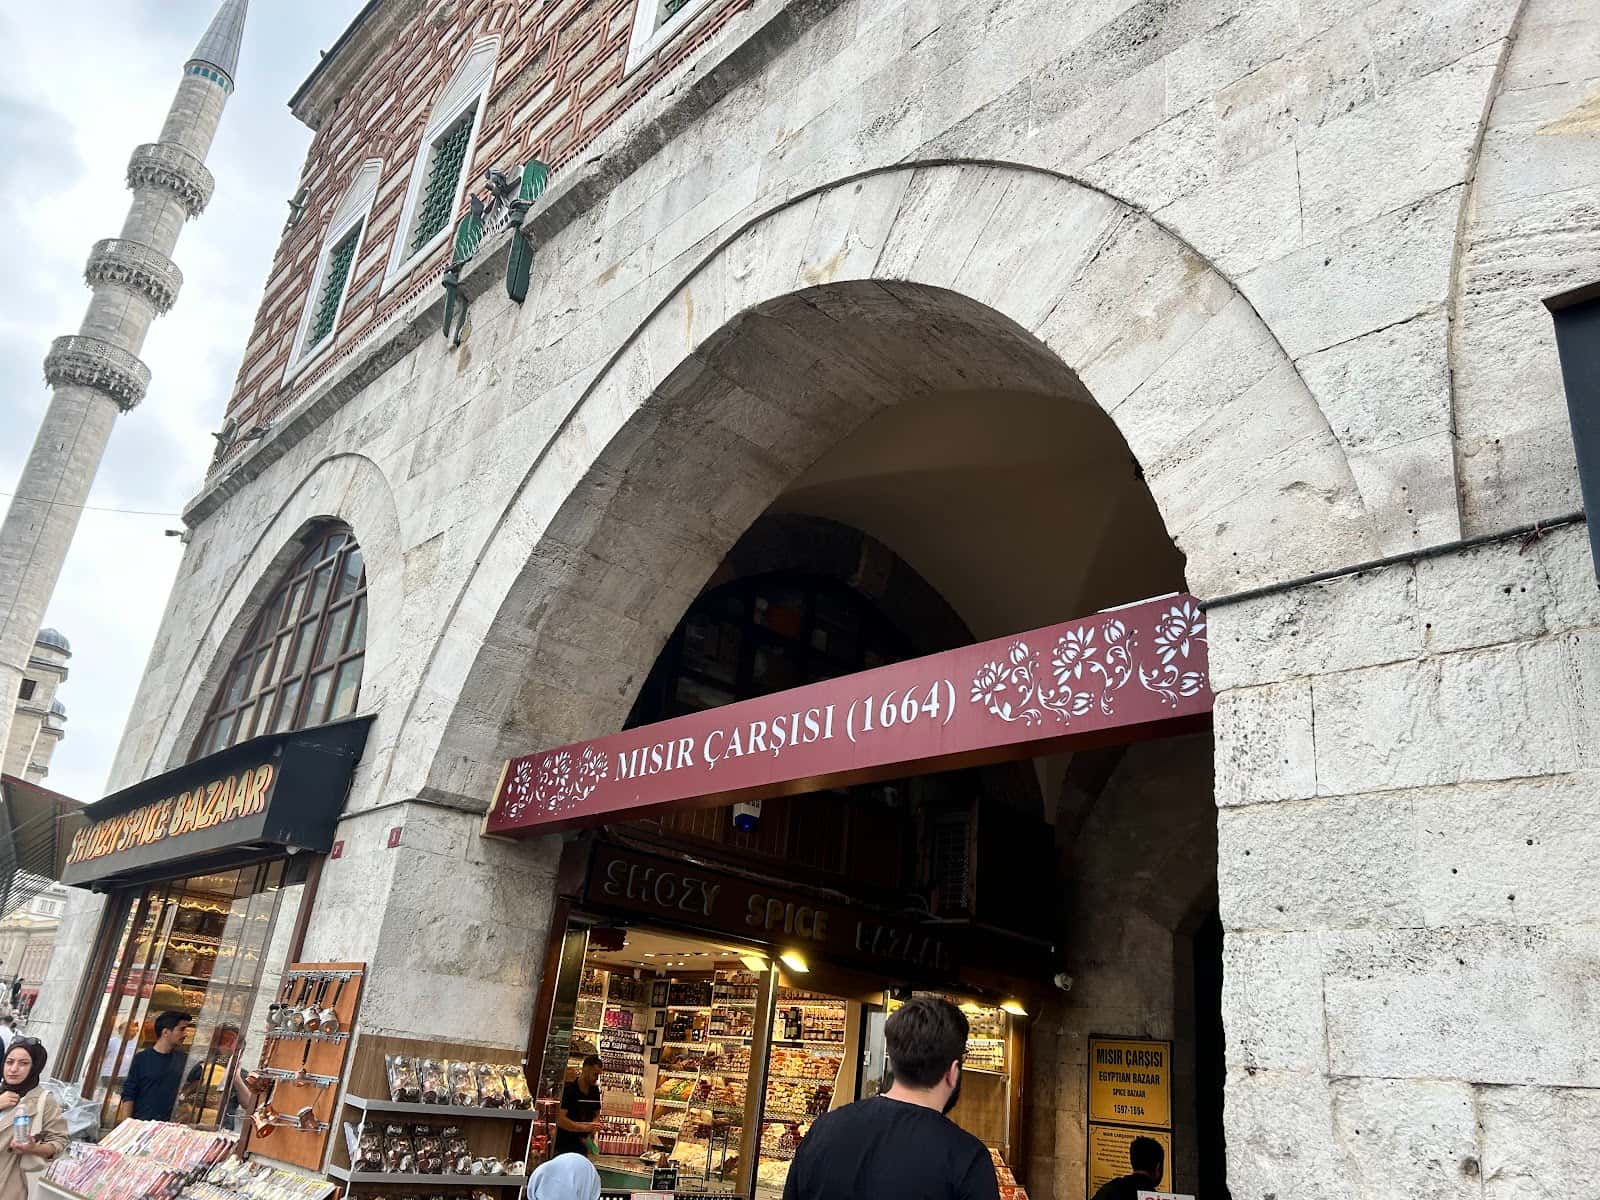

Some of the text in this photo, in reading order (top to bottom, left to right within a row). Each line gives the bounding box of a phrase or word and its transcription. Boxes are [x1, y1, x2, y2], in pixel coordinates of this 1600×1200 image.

[614, 679, 957, 782] MISIR ÇARŞISI (1664)
[117, 795, 178, 852] SPICE
[168, 764, 274, 837] BAZAAR
[603, 859, 830, 941] SHOZY SPICE
[1096, 1048, 1163, 1069] MISIR ÇARŞISI
[1098, 1071, 1160, 1085] EGYPTIAN BAZAAR
[1112, 1088, 1146, 1098] SPICE BAZAAR
